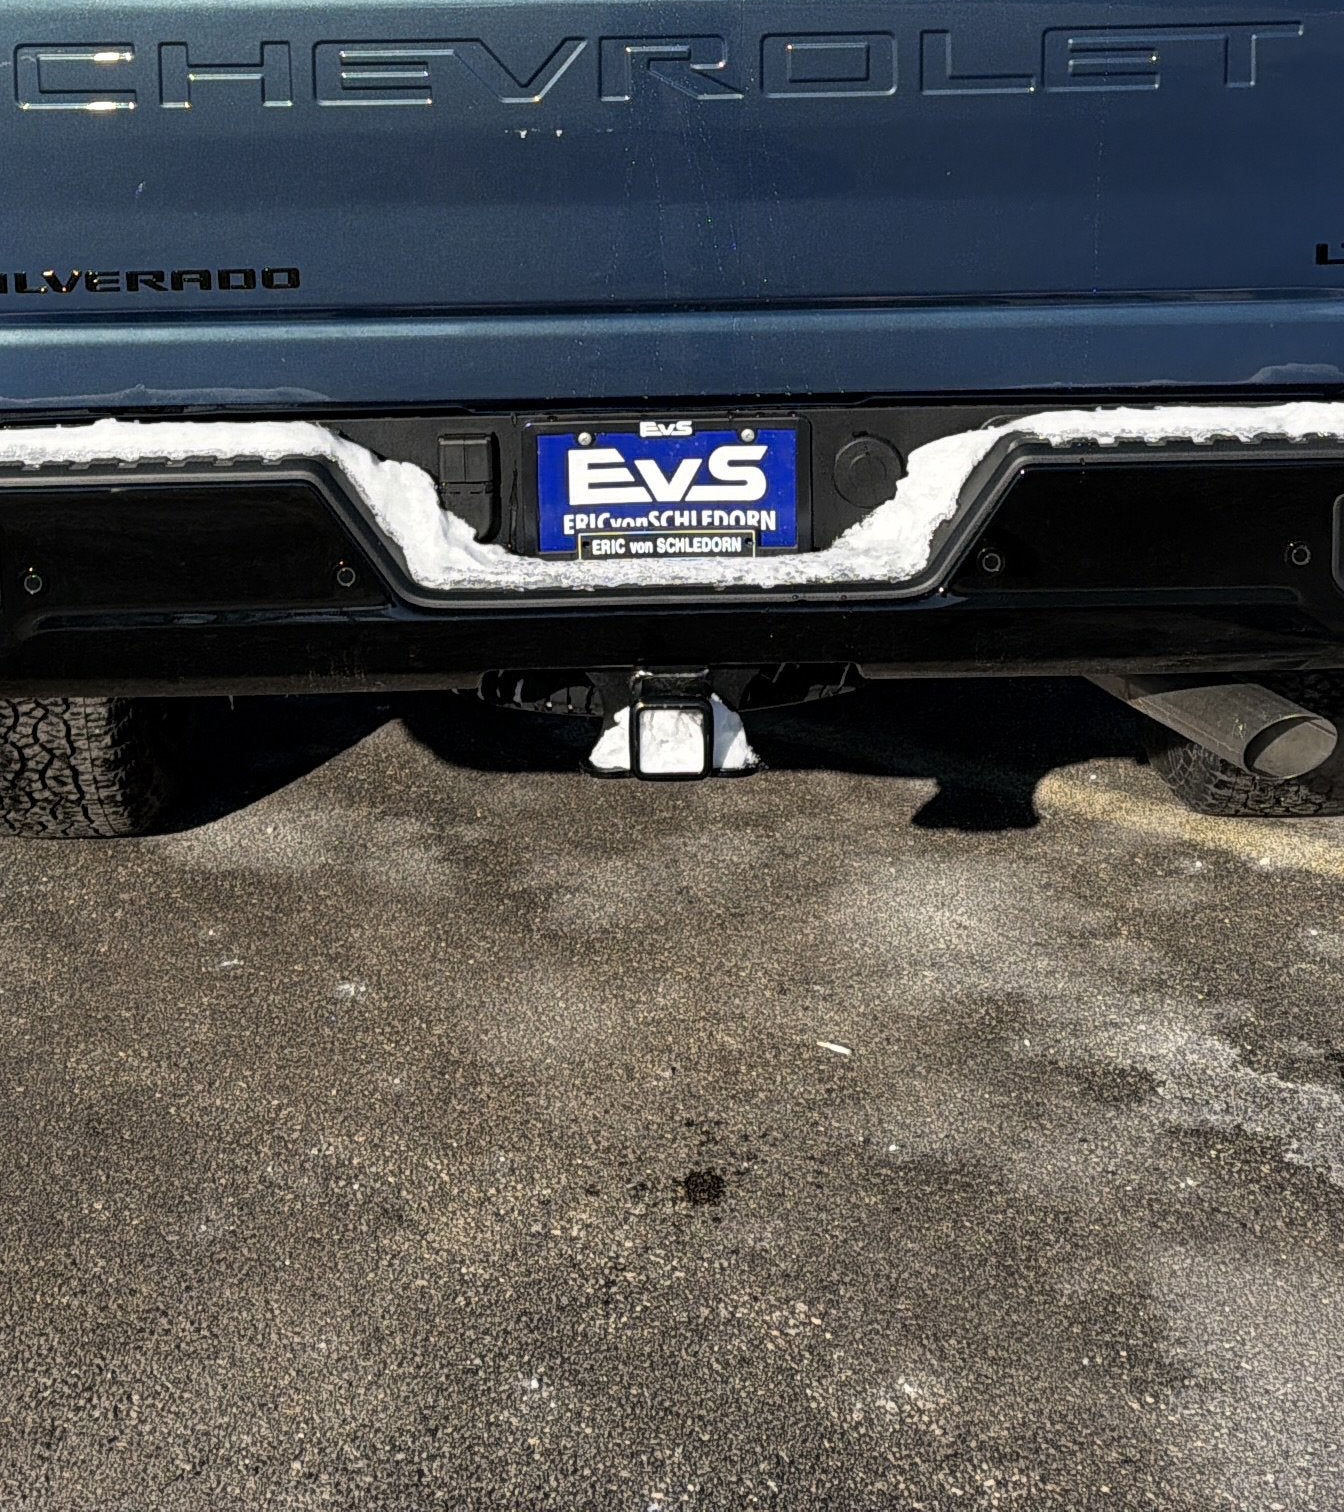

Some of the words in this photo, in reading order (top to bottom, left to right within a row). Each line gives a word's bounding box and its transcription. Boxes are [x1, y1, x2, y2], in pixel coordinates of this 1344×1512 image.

[13, 19, 1304, 110] CHEVROLET
[592, 538, 626, 555] ERIC
[629, 541, 653, 554] von
[656, 537, 742, 554] SCHLEDORN
